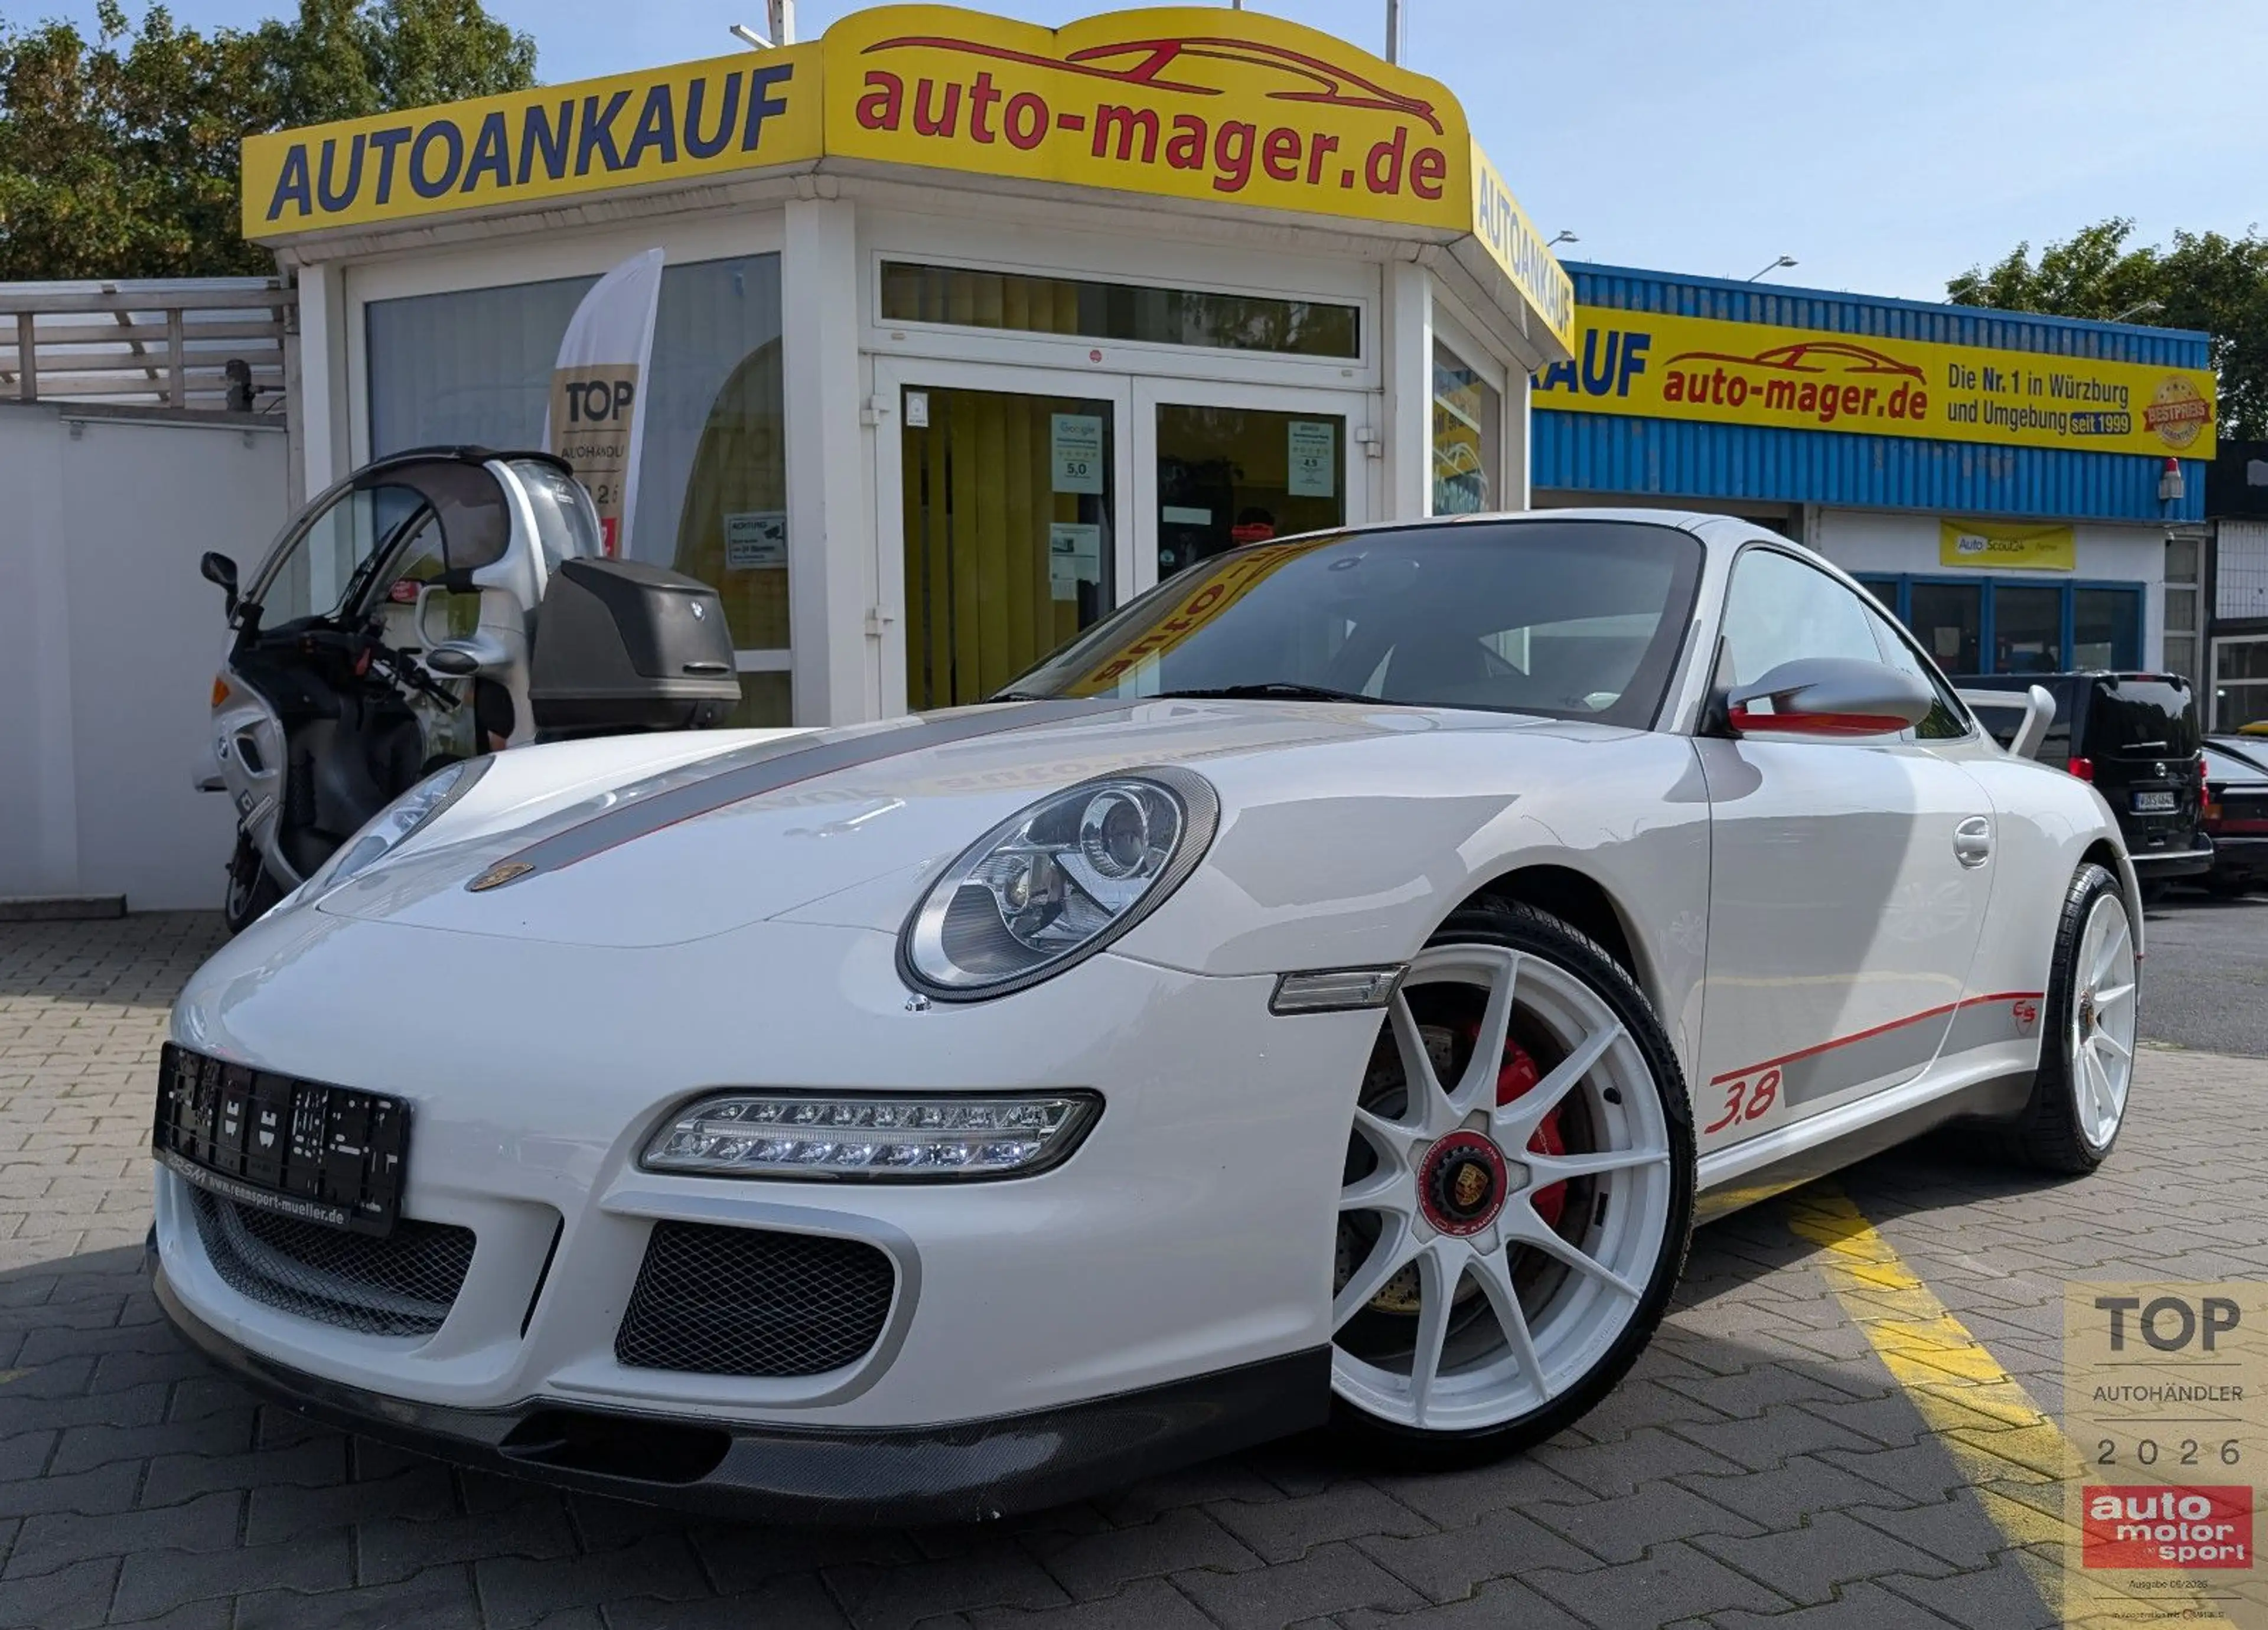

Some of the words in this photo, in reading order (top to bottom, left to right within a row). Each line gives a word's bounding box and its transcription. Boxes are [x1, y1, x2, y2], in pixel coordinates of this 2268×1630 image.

[266, 63, 794, 221] AUTOANKAUF
[856, 70, 1446, 201] auto-mager.de
[1479, 165, 1570, 338] AUTOANKAUF
[1531, 328, 1651, 397] AUF
[1948, 363, 1976, 390] Die
[1982, 367, 2006, 393] Nr.
[2011, 370, 2020, 394] 1
[2028, 370, 2042, 396] in
[2049, 373, 2129, 409] Würzburg
[565, 380, 635, 422] TOP
[1663, 367, 1928, 422] auto-mager.de
[1947, 399, 1978, 423] und
[1983, 400, 2067, 435] Umgebung
[2071, 414, 2096, 433] seit
[2098, 415, 2129, 433] 1999
